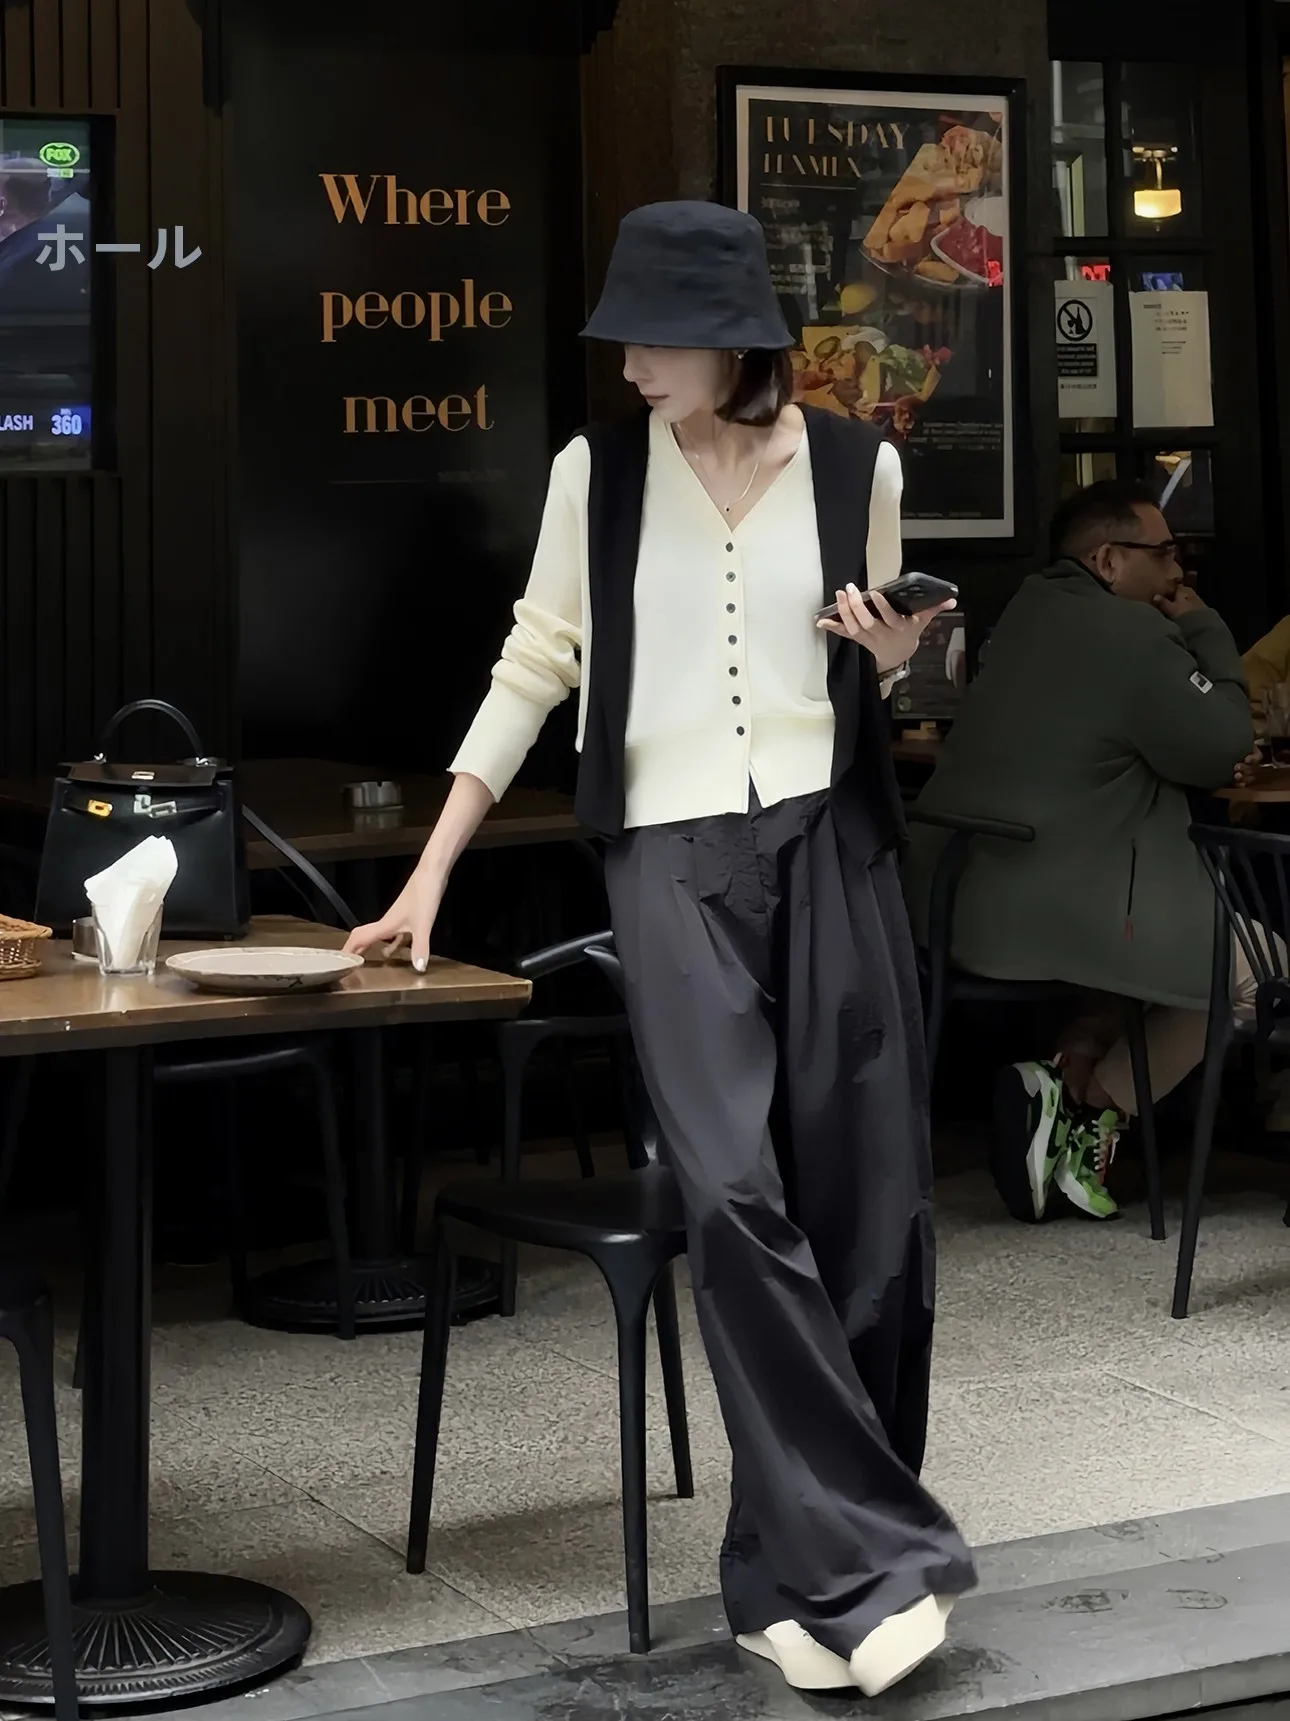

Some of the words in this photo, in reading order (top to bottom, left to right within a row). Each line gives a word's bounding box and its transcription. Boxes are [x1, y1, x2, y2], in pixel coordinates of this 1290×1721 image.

[763, 116, 910, 150] TUESDAY
[46, 148, 73, 161] FOX
[318, 173, 511, 226] Where
[319, 278, 513, 343] people
[51, 414, 82, 435] 360
[342, 384, 495, 433] meet
